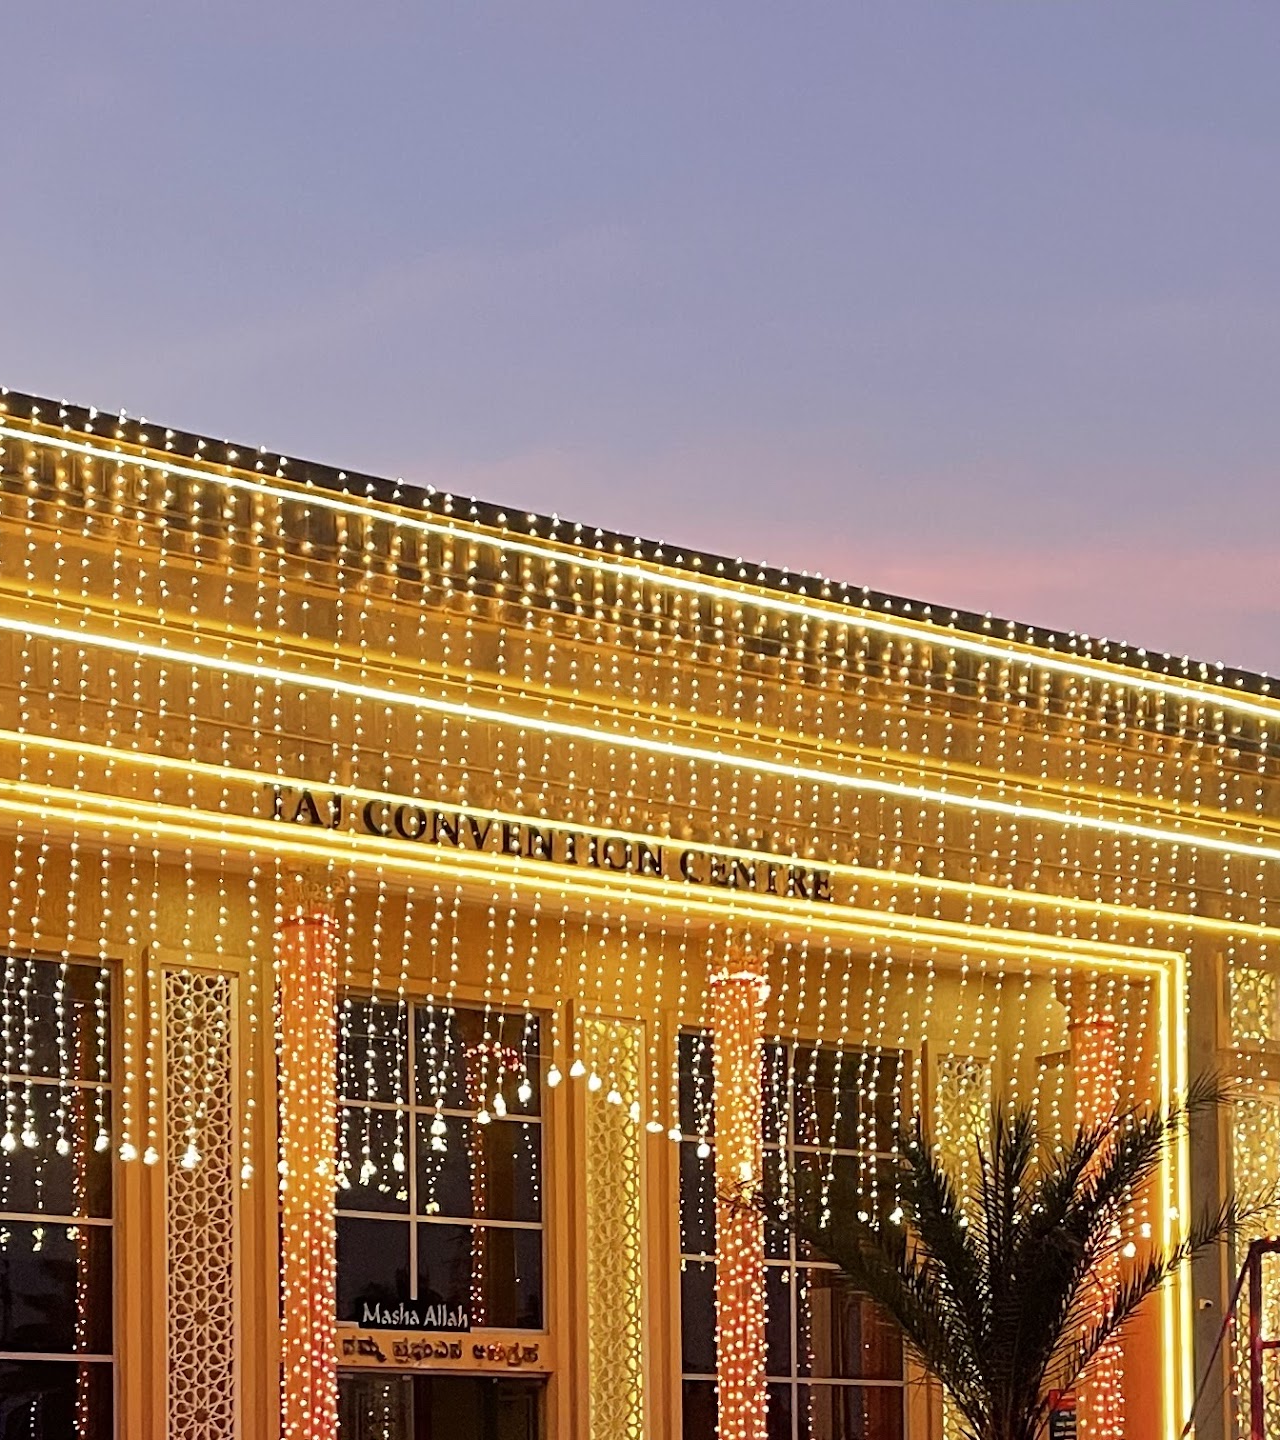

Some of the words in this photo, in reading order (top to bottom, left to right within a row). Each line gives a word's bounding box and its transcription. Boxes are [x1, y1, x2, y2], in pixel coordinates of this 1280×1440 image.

[263, 782, 343, 830] TAJ
[362, 798, 664, 878] CONVENTION
[679, 848, 833, 903] CENTRE
[363, 1302, 420, 1326] Masha
[423, 1304, 469, 1328] Allah
